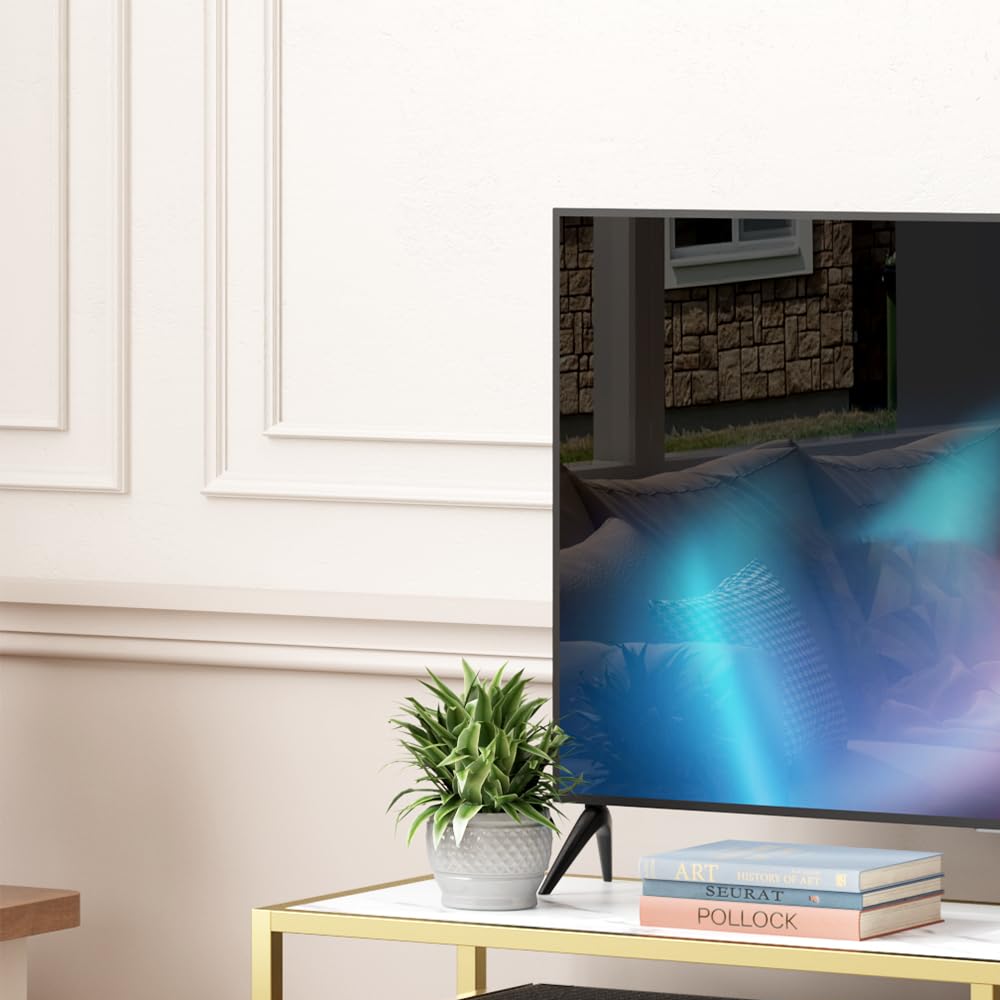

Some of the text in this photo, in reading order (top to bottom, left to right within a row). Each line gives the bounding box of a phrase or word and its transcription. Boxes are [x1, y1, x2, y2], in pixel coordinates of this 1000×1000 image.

[673, 863, 720, 882] ART
[705, 885, 784, 901] SEURAT
[697, 907, 798, 930] POLLOCK
